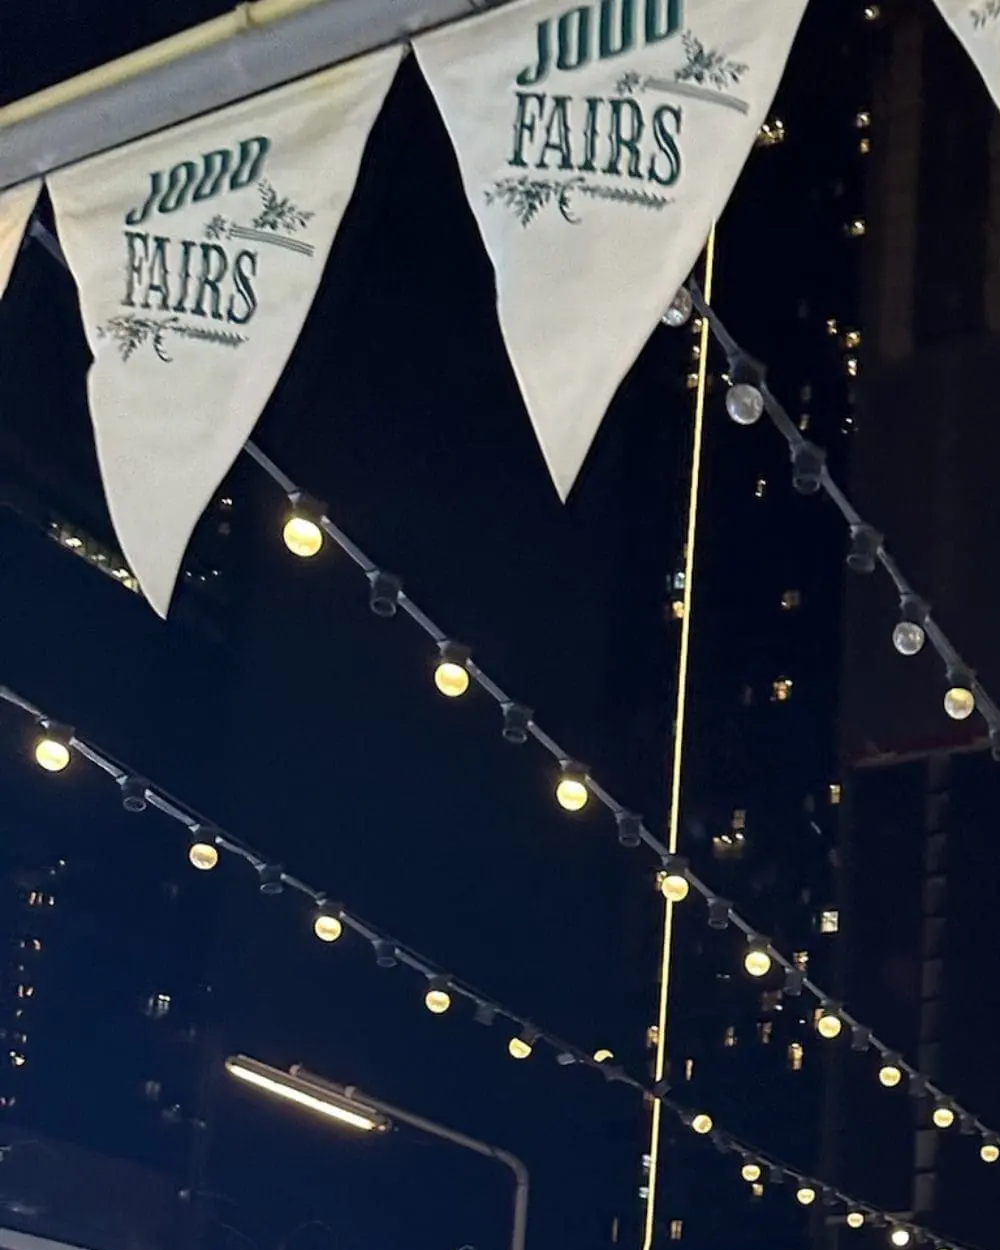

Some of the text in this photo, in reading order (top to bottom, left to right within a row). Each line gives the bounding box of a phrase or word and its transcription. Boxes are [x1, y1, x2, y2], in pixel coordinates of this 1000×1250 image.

[125, 136, 270, 226] JODD
[507, 91, 683, 187] FAIRS
[120, 230, 258, 325] FAIRS
